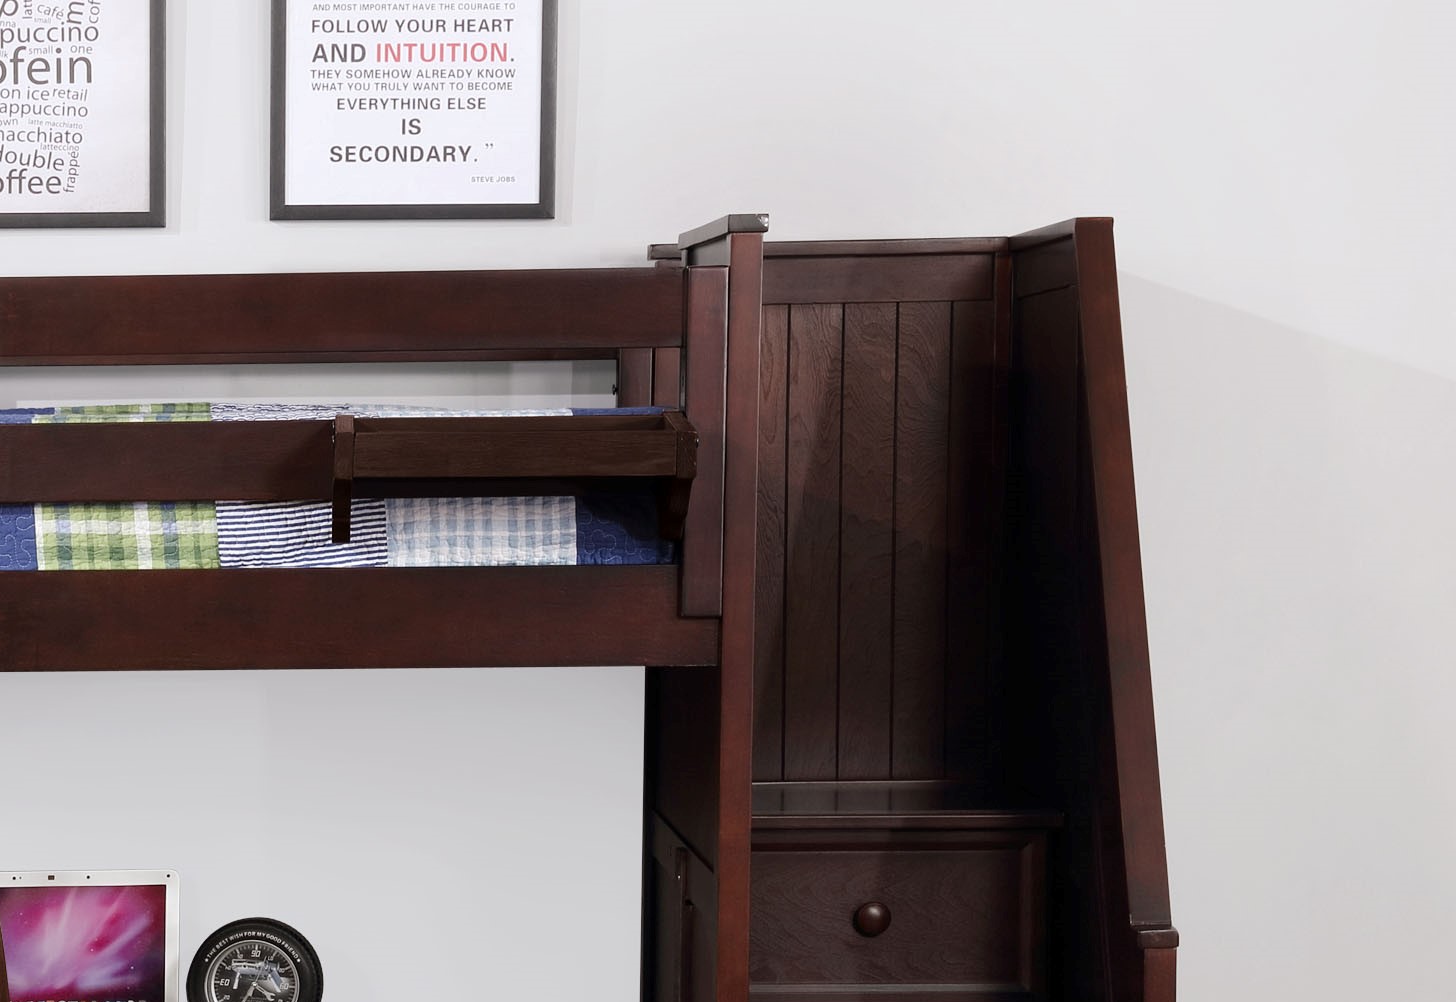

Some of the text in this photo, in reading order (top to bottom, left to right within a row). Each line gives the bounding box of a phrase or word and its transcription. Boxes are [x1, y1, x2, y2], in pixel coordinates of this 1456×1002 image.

[37, 4, 64, 20] café
[313, 3, 330, 11] AND
[333, 3, 357, 11] MOST
[360, 3, 410, 11] IMPORTANT
[504, 2, 516, 10] TO
[312, 18, 514, 33] FOLLOW YOUR HEART
[28, 45, 54, 54] small
[70, 45, 93, 54] one
[312, 42, 514, 63] AND INTUITION.
[310, 68, 516, 79] THEY SOMEHOW ALREADY KNOW
[0, 86, 50, 100] on ice
[311, 82, 513, 91] WHAT YOU TRULY WANT TO BECOME
[52, 88, 88, 101] retail
[337, 97, 486, 110] EVERYTHING ELSE
[401, 118, 421, 135] IS
[40, 142, 80, 151] latteccino
[63, 151, 80, 192] frappé
[206, 947, 217, 959] THE
[215, 937, 230, 950] BEST
[265, 933, 282, 944] GOOD
[281, 940, 299, 959] FRIEND
[219, 978, 231, 987] 03
